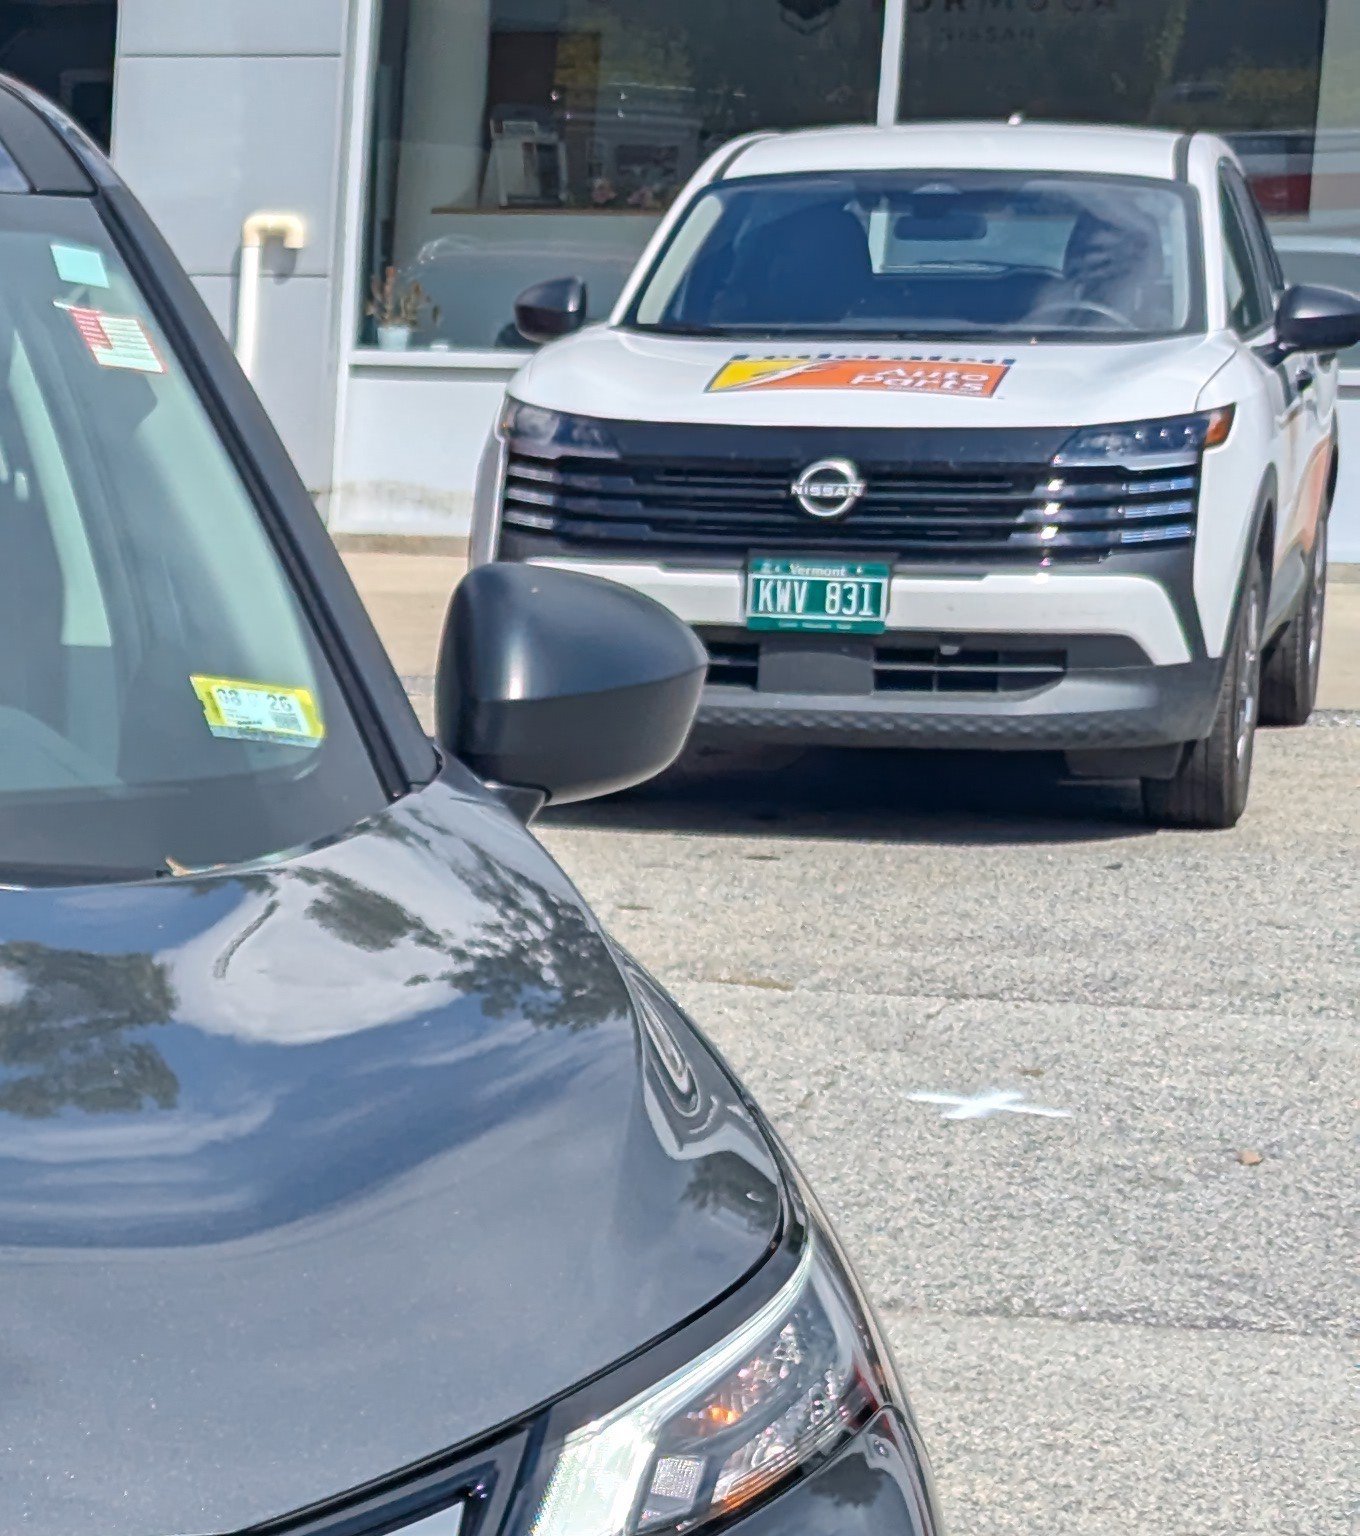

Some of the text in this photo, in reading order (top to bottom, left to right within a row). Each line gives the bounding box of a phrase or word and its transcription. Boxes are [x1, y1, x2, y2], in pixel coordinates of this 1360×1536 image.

[874, 367, 990, 383] Auto
[790, 481, 867, 497] NISSAN
[789, 562, 848, 577] Vermont
[757, 579, 874, 616] KWV 831
